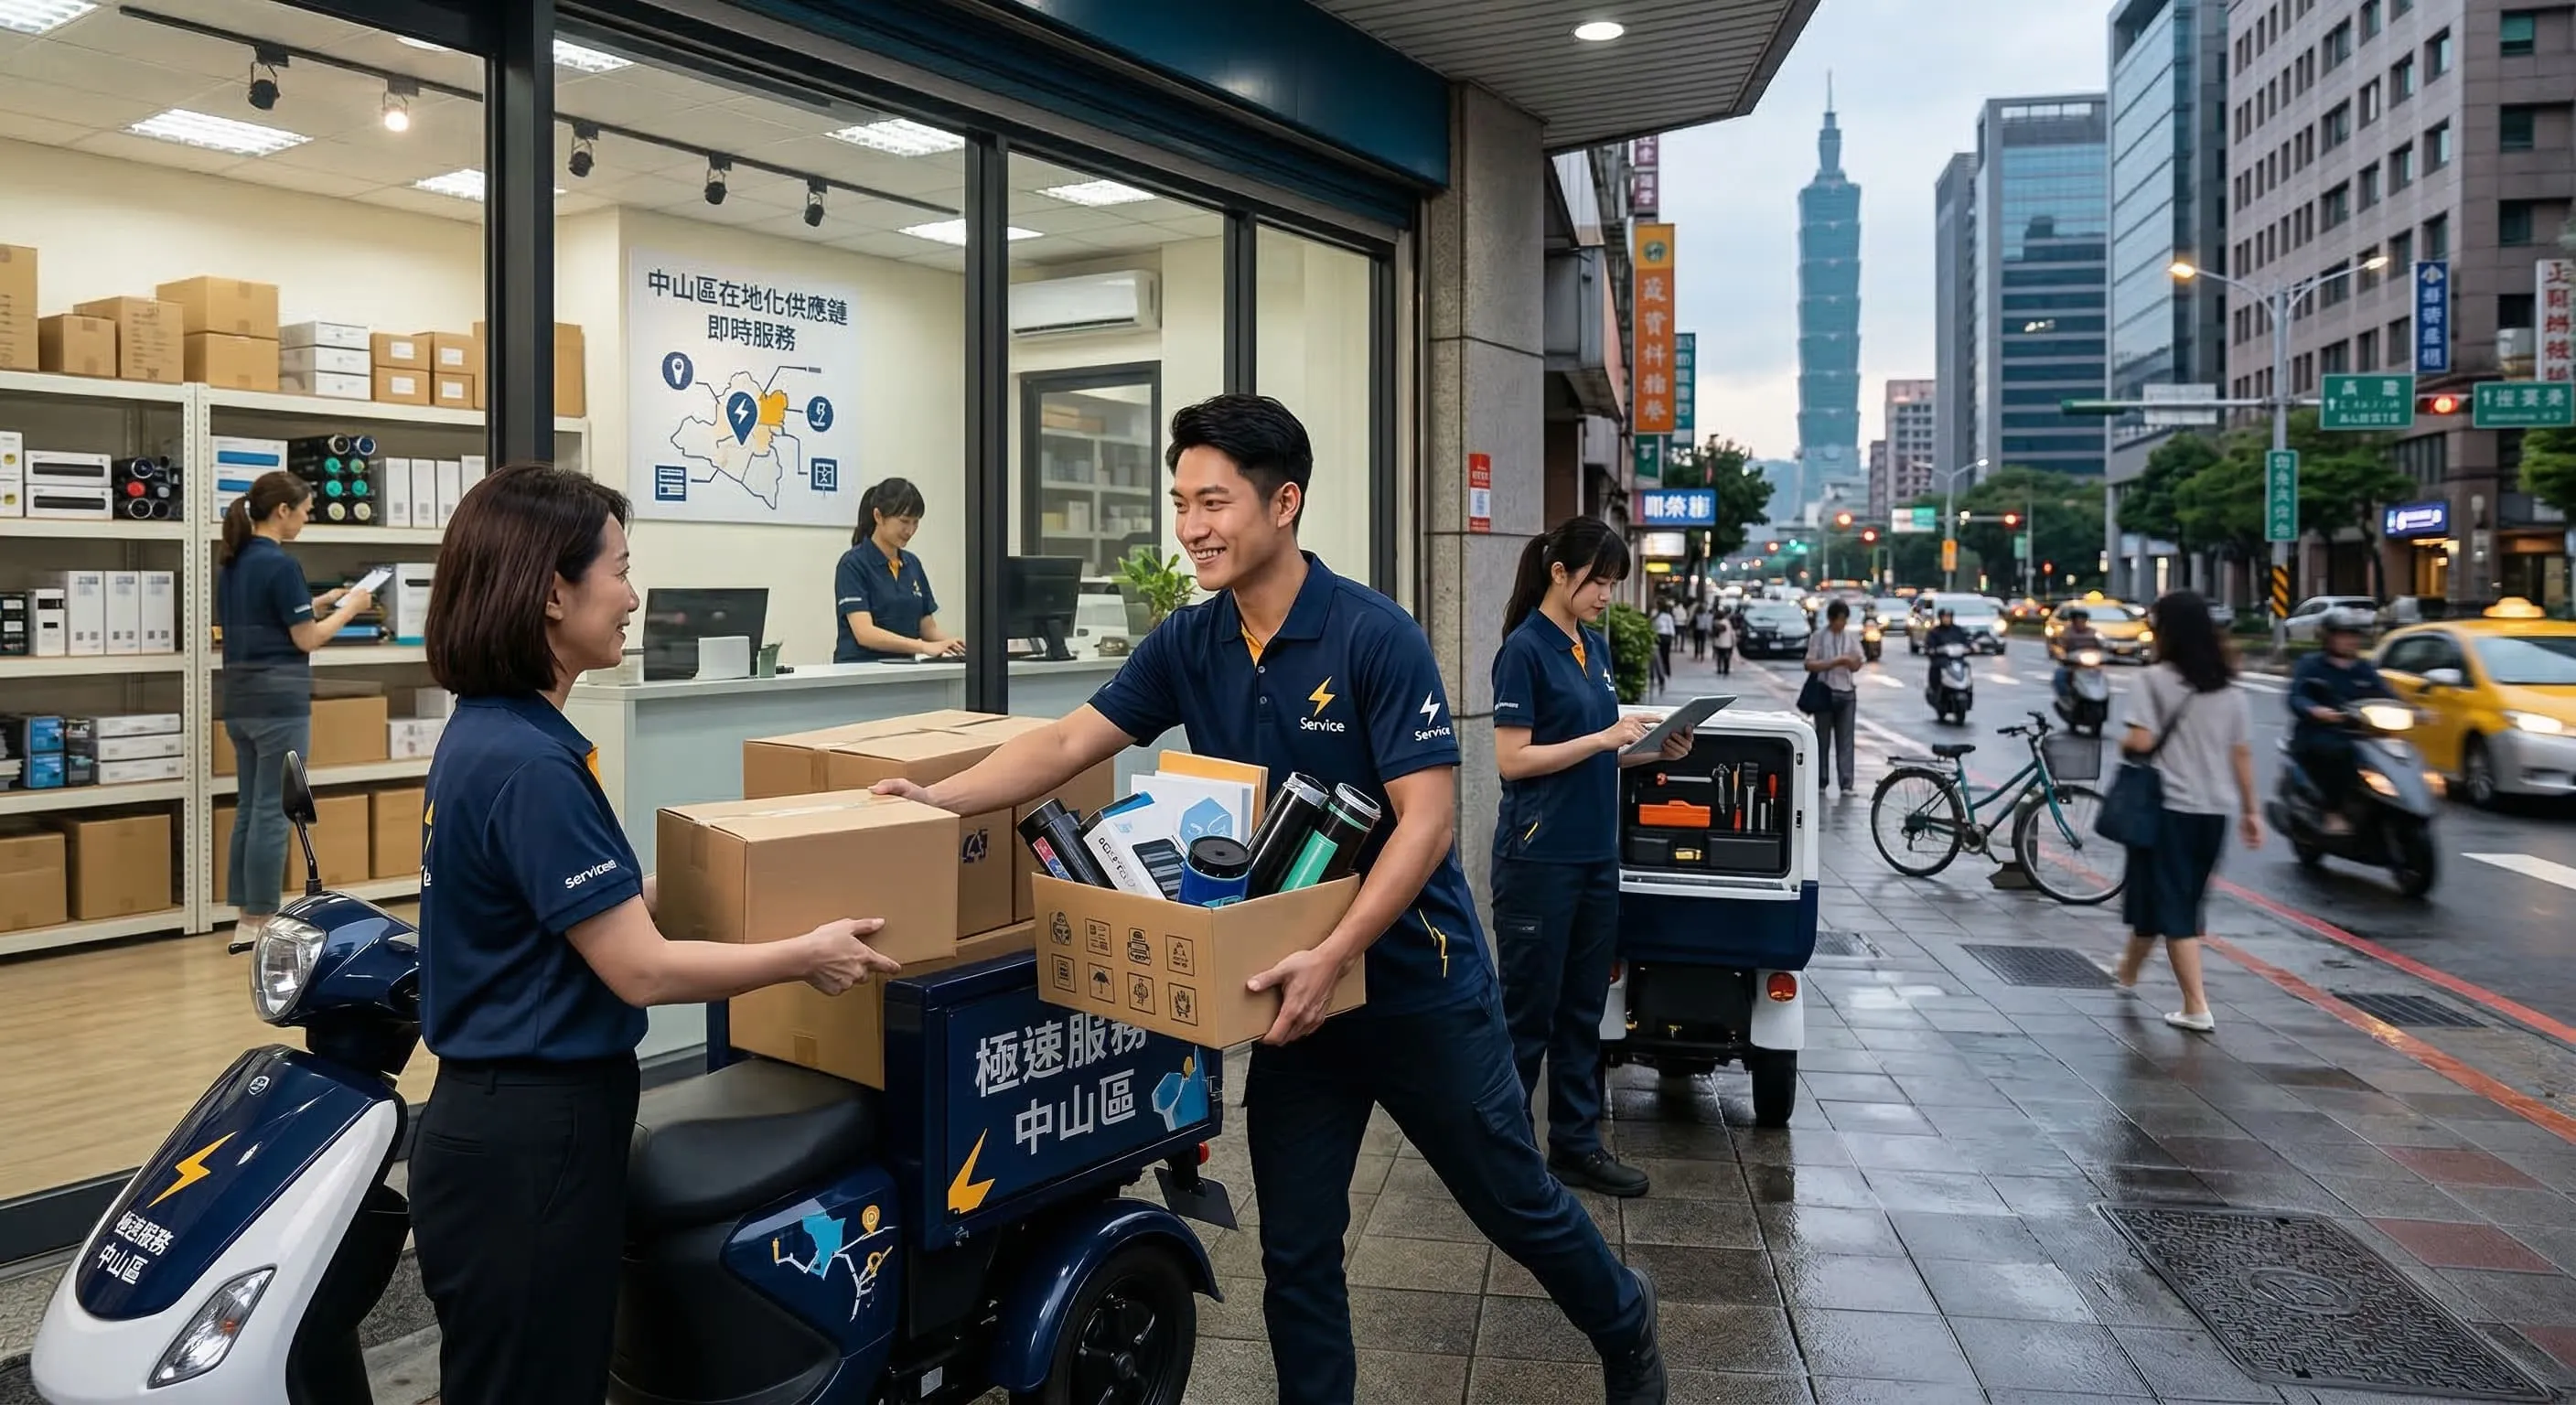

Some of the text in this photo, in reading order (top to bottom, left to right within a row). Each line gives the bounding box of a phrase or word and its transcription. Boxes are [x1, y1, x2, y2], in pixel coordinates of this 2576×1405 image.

[648, 268, 848, 326] 中山區在地化供應鏈
[707, 315, 797, 351] 即時服務
[1299, 716, 1346, 733] Service
[1414, 725, 1451, 742] Service
[974, 1013, 1147, 1098] 極速服務
[1014, 1068, 1136, 1156] 中山區
[96, 1241, 149, 1285] 中山區
